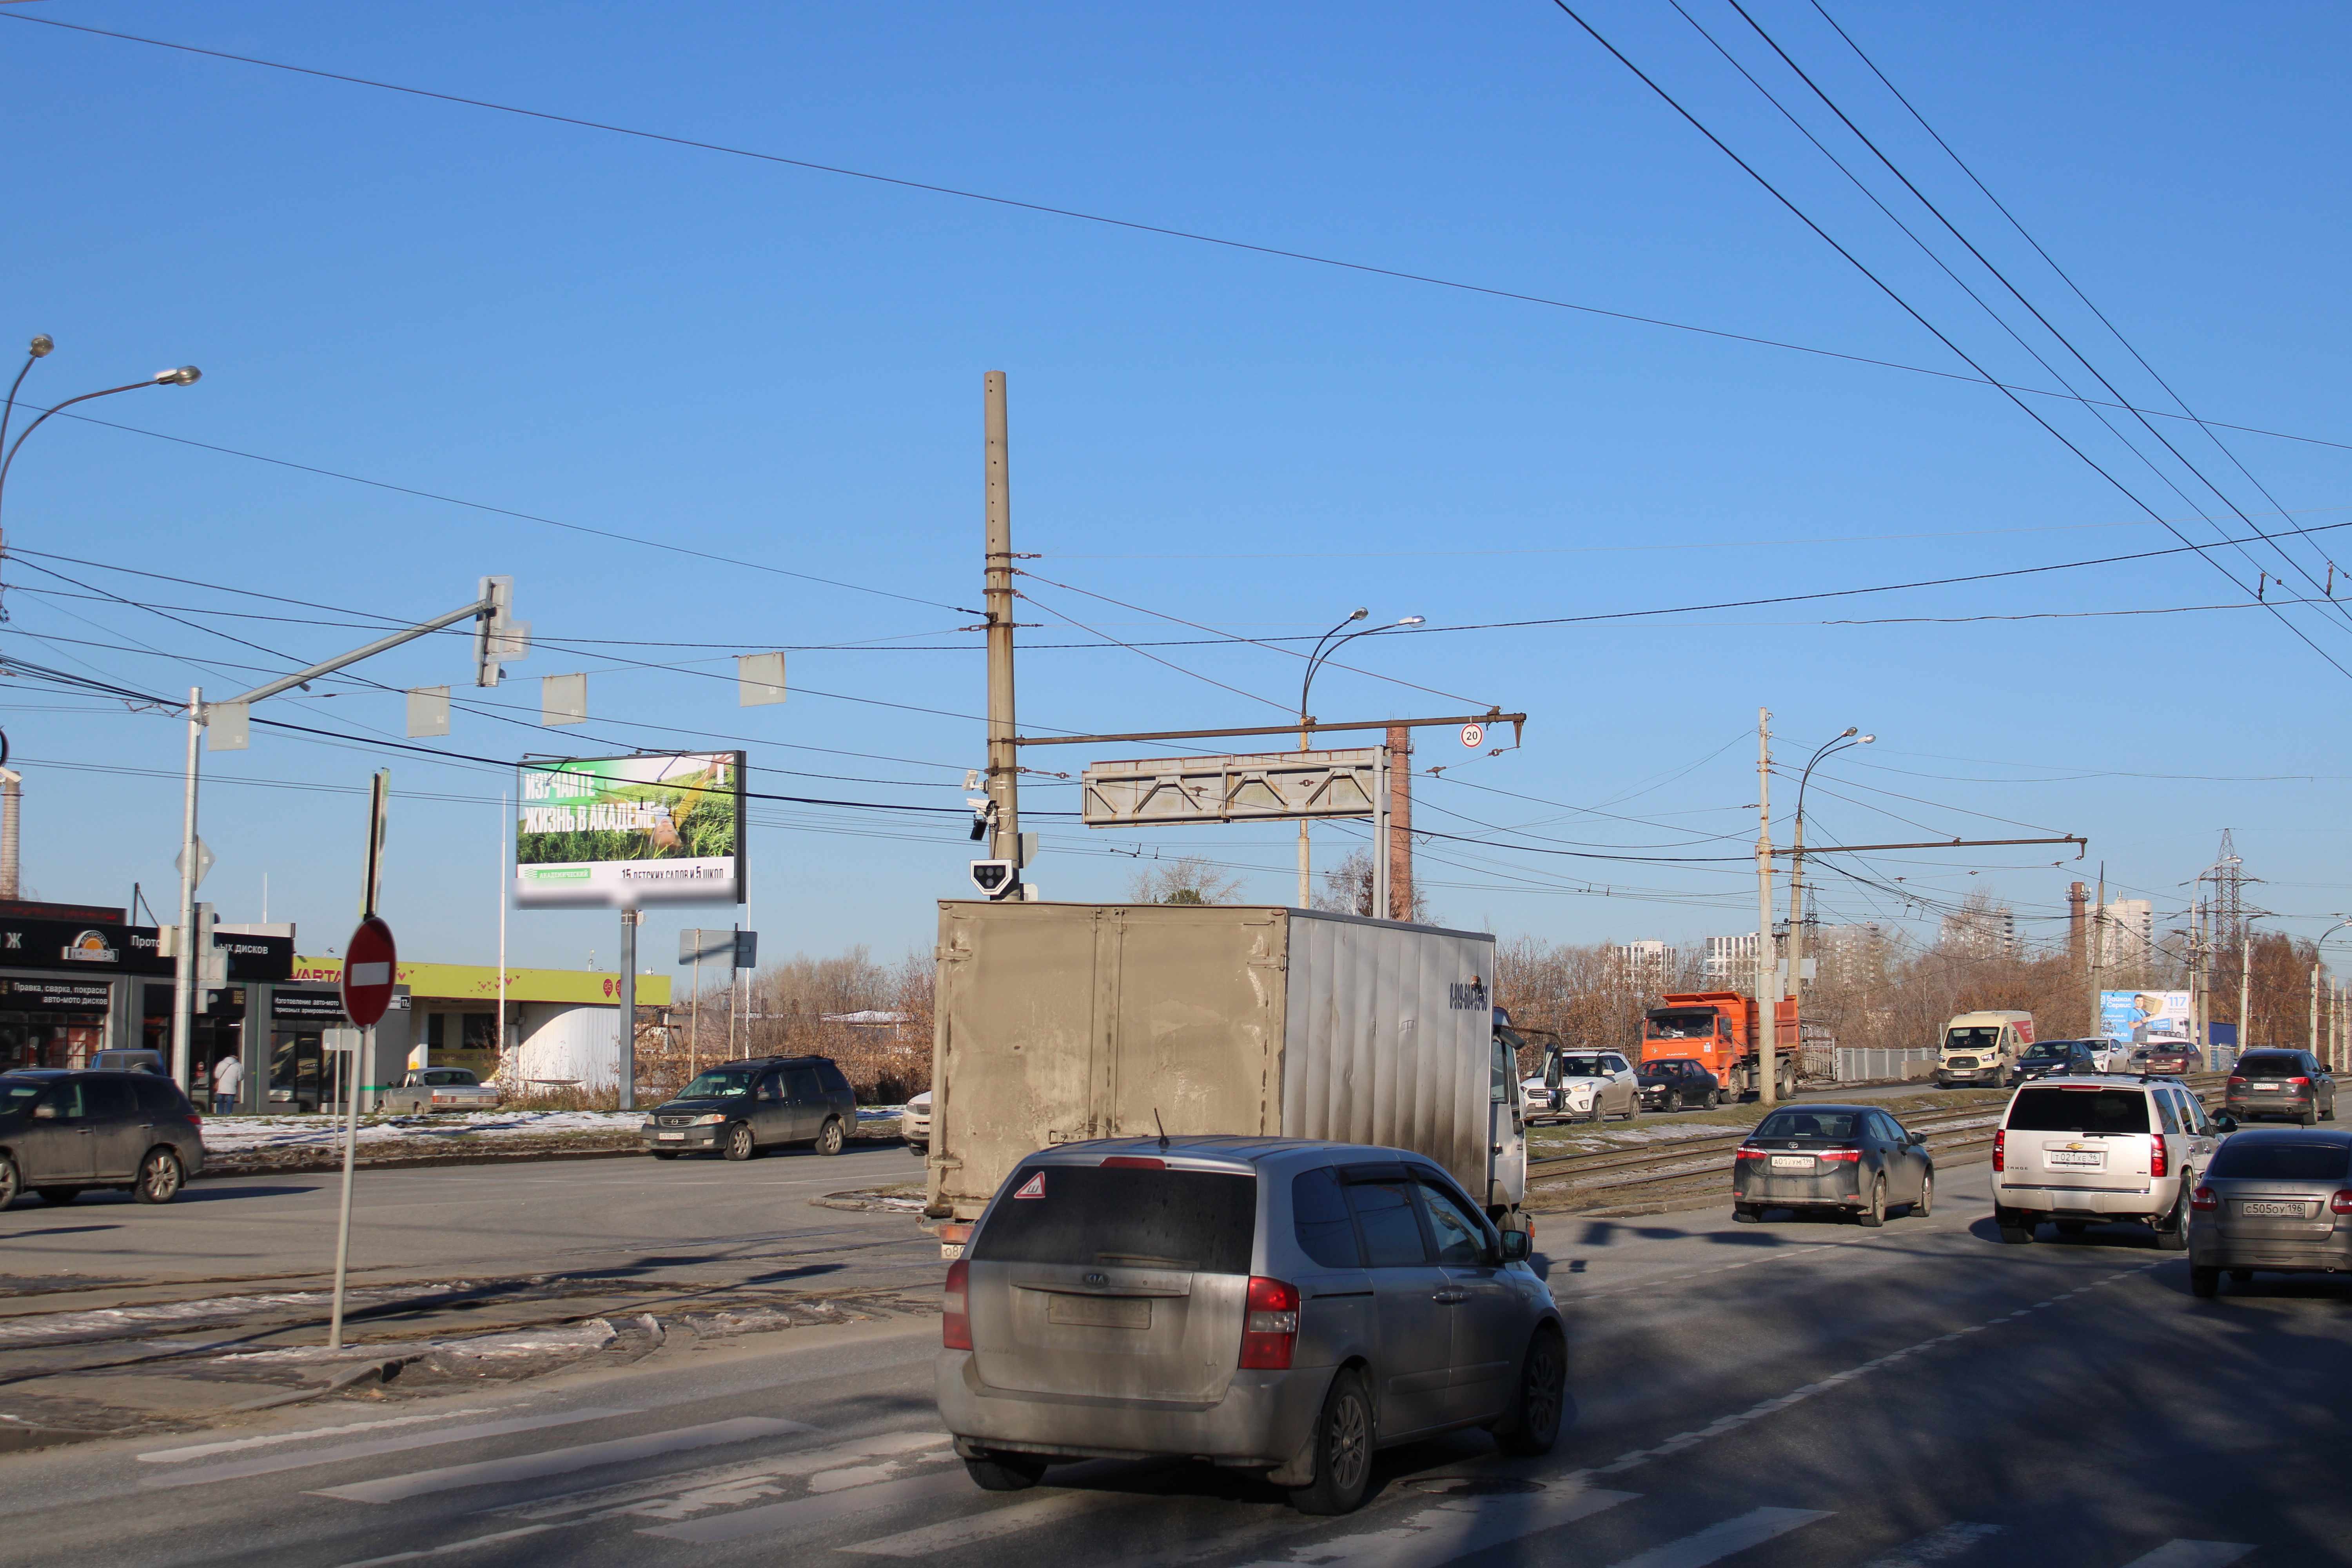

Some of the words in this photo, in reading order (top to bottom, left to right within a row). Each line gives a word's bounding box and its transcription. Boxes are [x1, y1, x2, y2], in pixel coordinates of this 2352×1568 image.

[1466, 731, 1478, 740] 20
[525, 767, 595, 800] ИЗУЧАЙТЕ
[524, 806, 575, 833] ЖИЗНЬ
[577, 805, 588, 832] В
[590, 802, 656, 833] АКАДЕМЕ
[539, 869, 588, 878] АКАДЕМИЧЕСКИЙ
[622, 869, 631, 878] 15
[696, 866, 701, 878] 5
[81, 931, 107, 946] МАСТЕРСКАЯ
[235, 944, 269, 955] дисков
[14, 982, 44, 993] Правка,
[45, 985, 73, 994] сварка,
[74, 987, 107, 995] покраска
[604, 983, 612, 992] 95
[2168, 997, 2187, 1007] 117
[2055, 1153, 2086, 1162] Т021ХЕ
[2245, 1204, 2285, 1214] С505ОУ
[1085, 1274, 1105, 1283] KIA
